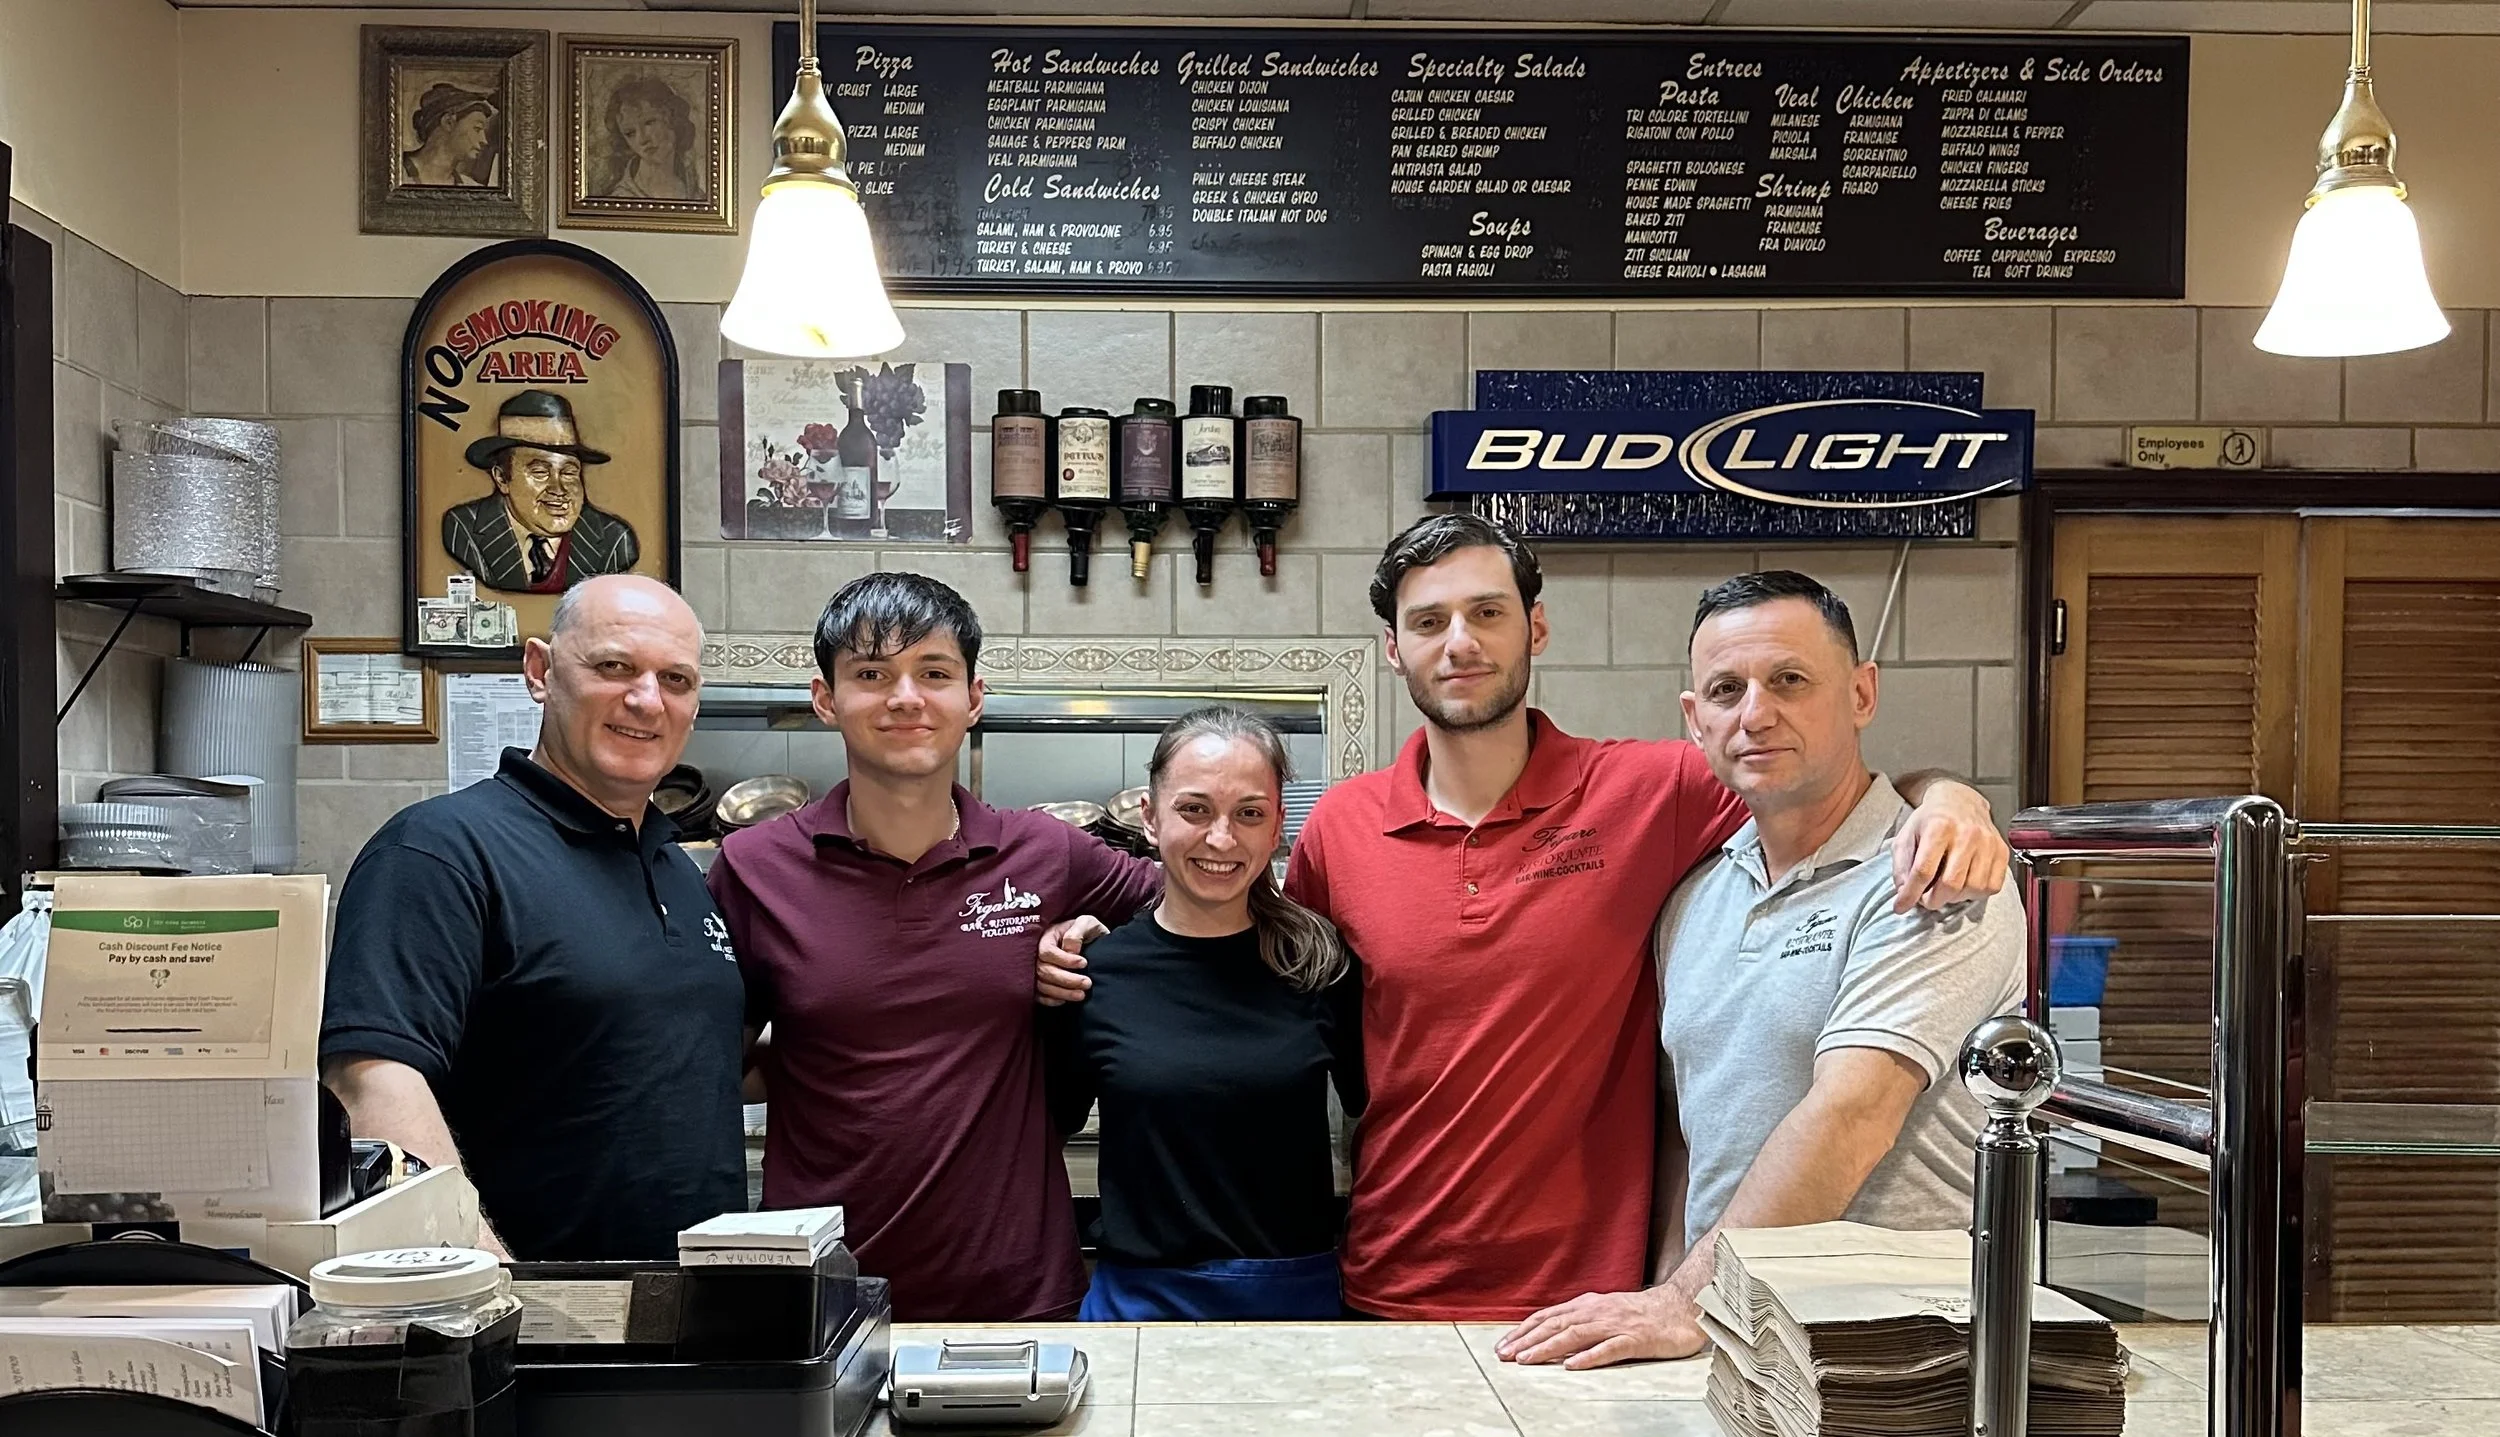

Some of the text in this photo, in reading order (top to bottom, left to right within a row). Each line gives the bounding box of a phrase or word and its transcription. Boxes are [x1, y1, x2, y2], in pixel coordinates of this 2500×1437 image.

[855, 45, 914, 80] Pizza
[991, 48, 1160, 76] Hot Sandwiches
[1177, 50, 1379, 87] Grilled Sandwiches
[1407, 52, 1586, 85] Specialty Salads
[1686, 52, 1762, 80] Entrees
[1899, 55, 2163, 89] Appetizers & Side Orders
[836, 83, 872, 97] CRUST
[883, 83, 919, 98] LARGE
[986, 79, 1105, 95] MEATBALL PARMIGIANA
[1191, 80, 1269, 95] CHICKEN DIJON
[1659, 80, 1720, 107] Pasta
[1390, 89, 1515, 104] CAJUN CHICKEN CAESAR
[1774, 83, 1820, 108] Veal
[1835, 84, 1914, 115] Chicken
[1941, 88, 2028, 103] FRIED CALAMARI
[883, 101, 925, 116] MEDIUM
[987, 97, 1106, 113] EGGPLANT PARMIGIANA
[1191, 98, 1290, 113] CHICKEN LOUISIANA
[1391, 107, 1482, 122] GRILLED CHICKEN
[1626, 108, 1750, 124] TRI COLORE TORTELLINI
[1770, 113, 1821, 128] MILANESE
[1849, 114, 1903, 129] ARMIGIANA
[1941, 107, 2028, 122] ZUPPA DI CLAMS
[987, 114, 1096, 132] CHICKEN PARMIGIANA
[1191, 116, 1276, 132] CRISPY CHICKEN
[847, 124, 920, 140] PIZZA LARGE
[1626, 125, 1735, 141] RIGATONI CON POLLO
[1771, 129, 1810, 144] PICIOLA
[1843, 130, 1899, 145] FRANCAISE
[884, 142, 926, 157] MEDIUM
[1191, 135, 1284, 150] BUFFALO CHICKEN
[1940, 142, 2021, 157] BUFFALO WINGS
[1390, 144, 1501, 159] PAN SEARED SHRIMP
[1769, 146, 1817, 161] MARSALA
[1842, 147, 1908, 162] SORRENTINO
[987, 152, 1078, 168] VEAL PARMIGIANA
[1940, 160, 2030, 175] CHICKEN FINGERS
[857, 161, 876, 175] PIE
[1390, 162, 1482, 177] ANTIPASTA SALAD
[1626, 160, 1746, 176] SPAGHETTI BOLOGNESE
[1842, 164, 1917, 180] SCARPARIELLO
[1191, 172, 1306, 187] PHILLY CHEESE STEAK
[1390, 179, 1572, 194] HOUSE GARDEN SALAD OR CAESAR
[1625, 177, 1698, 192] PENNE EDWIN
[1939, 178, 2046, 193] MOZZARELLA STICKS
[864, 180, 895, 195] SLICE
[983, 172, 1161, 204] Cold Sandwiches
[1754, 173, 1831, 204] Shrimp
[1841, 180, 1879, 195] FIGARO
[1625, 195, 1752, 211] HOUSE MADE SPAGHETTI
[1939, 195, 2013, 211] CHEESE FRIES
[1192, 208, 1234, 223] DOUBLE
[1237, 208, 1277, 223] ITALIAN
[1280, 208, 1302, 223] HOT
[1305, 208, 1328, 224] DOG
[1763, 204, 1824, 219] PARMIGIANA
[1468, 211, 1532, 242] Soups
[1624, 212, 1686, 227] BAKED ZITI
[976, 222, 1173, 239] SALAMI, HAM & PROVOLONE 6.95
[1765, 220, 1823, 235] FRANCAISE
[1984, 216, 2078, 249] Beverages
[1624, 230, 1679, 244] MANICOTTI
[1758, 237, 1826, 252] FRA DIAVOLO
[1624, 247, 1691, 262] ZITI SICILIAN
[1943, 248, 2116, 264] COFFEE CAPPUCCINO EXPRESSO
[1421, 262, 1496, 277] PASTA FAGIOLI
[1623, 264, 1767, 279] CHEESE RAVIOLI LASAGNA
[1972, 263, 2074, 279] TEA SOFT DRINKS
[417, 299, 622, 432] NO SMOKING
[476, 351, 589, 383] AREA
[1466, 429, 2009, 470] BUD LIGHT
[2138, 437, 2204, 449] Employees
[2138, 451, 2165, 462] Only
[959, 892, 1020, 921] Figaro
[99, 942, 222, 952] Cash Discount Fee Notice
[109, 954, 214, 964] Pay by cash and save!
